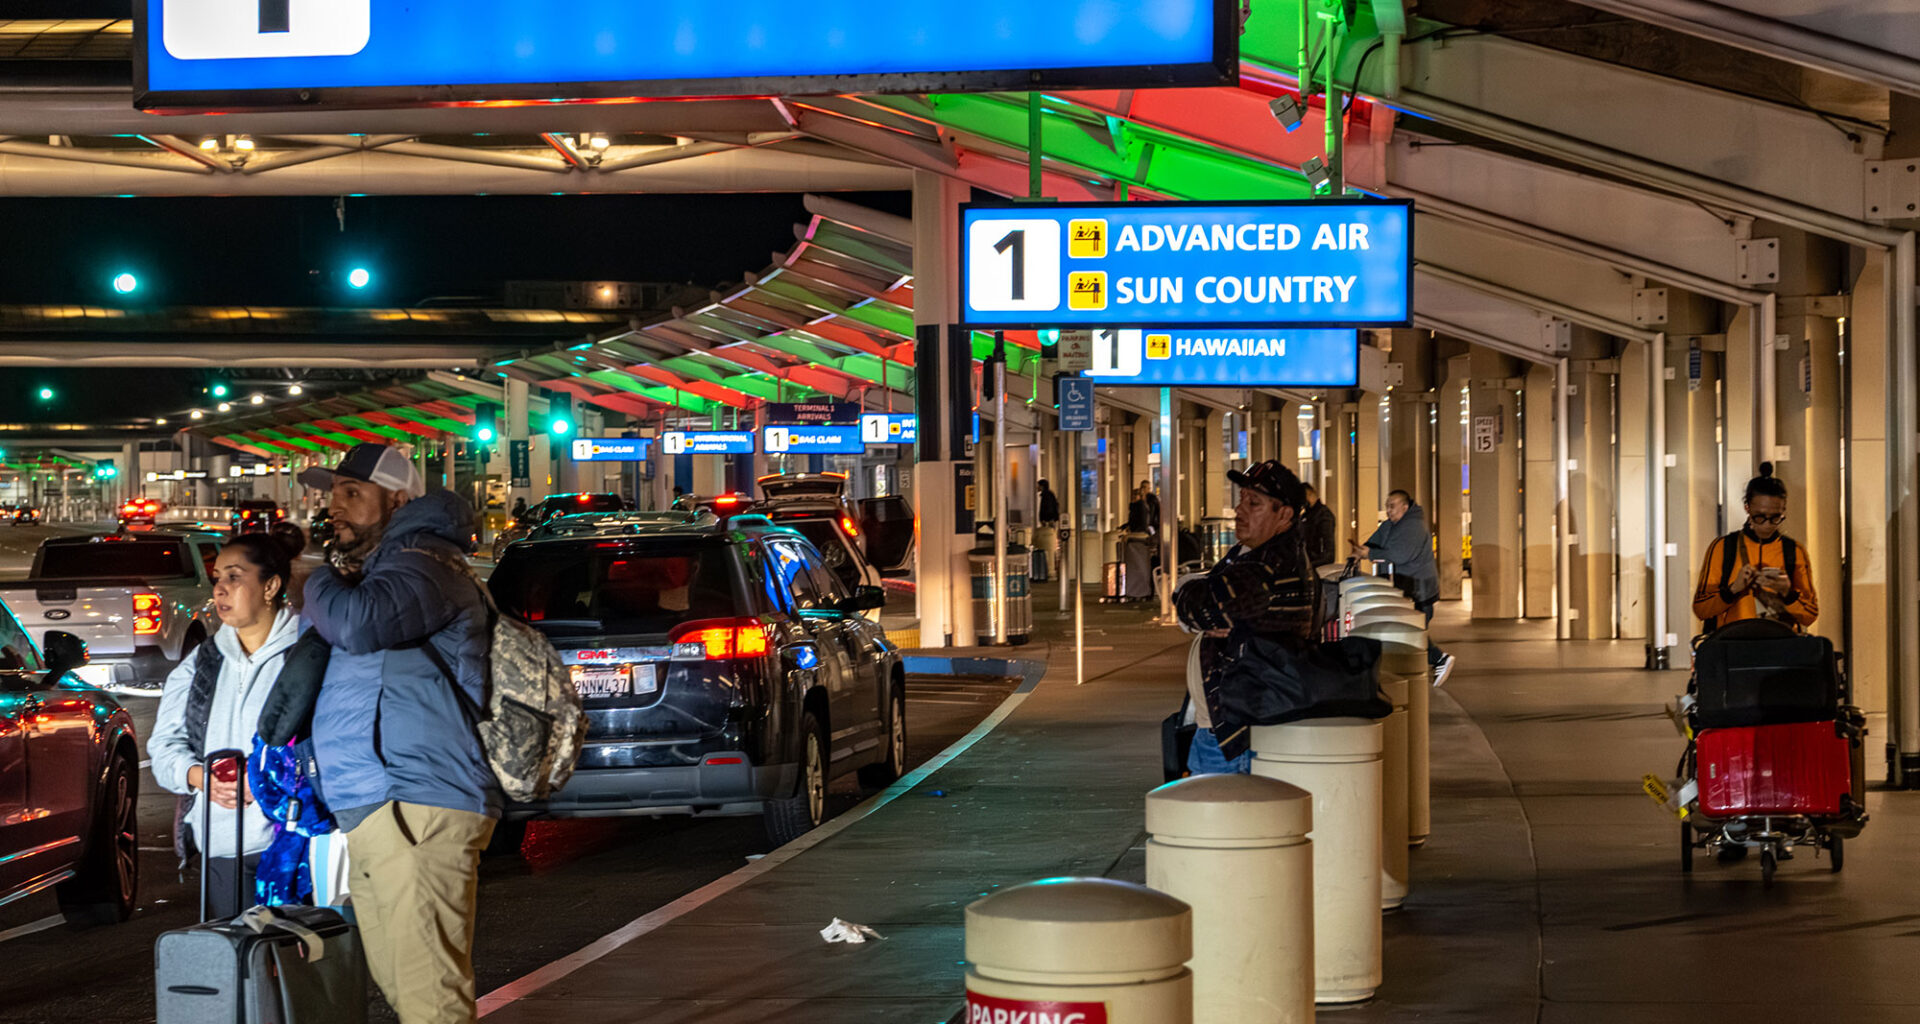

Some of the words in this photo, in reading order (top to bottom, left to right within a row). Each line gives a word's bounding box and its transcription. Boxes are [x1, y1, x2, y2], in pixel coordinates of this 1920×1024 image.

[1116, 224, 1300, 251] ADVANCED
[1312, 224, 1369, 249] AIR
[994, 231, 1024, 299] 1
[1117, 278, 1182, 303] SUN
[1196, 276, 1356, 303] COUNTRY
[1099, 329, 1119, 369] 1
[1177, 339, 1285, 356] HAWAIIAN
[797, 412, 832, 420] ARRIVALS
[870, 419, 880, 438] 1
[670, 436, 678, 450] 1
[773, 432, 781, 447] 1
[1478, 436, 1492, 450] 15
[580, 443, 585, 456] 1
[577, 650, 617, 660] GMC
[972, 1003, 1086, 1024] PARKING
